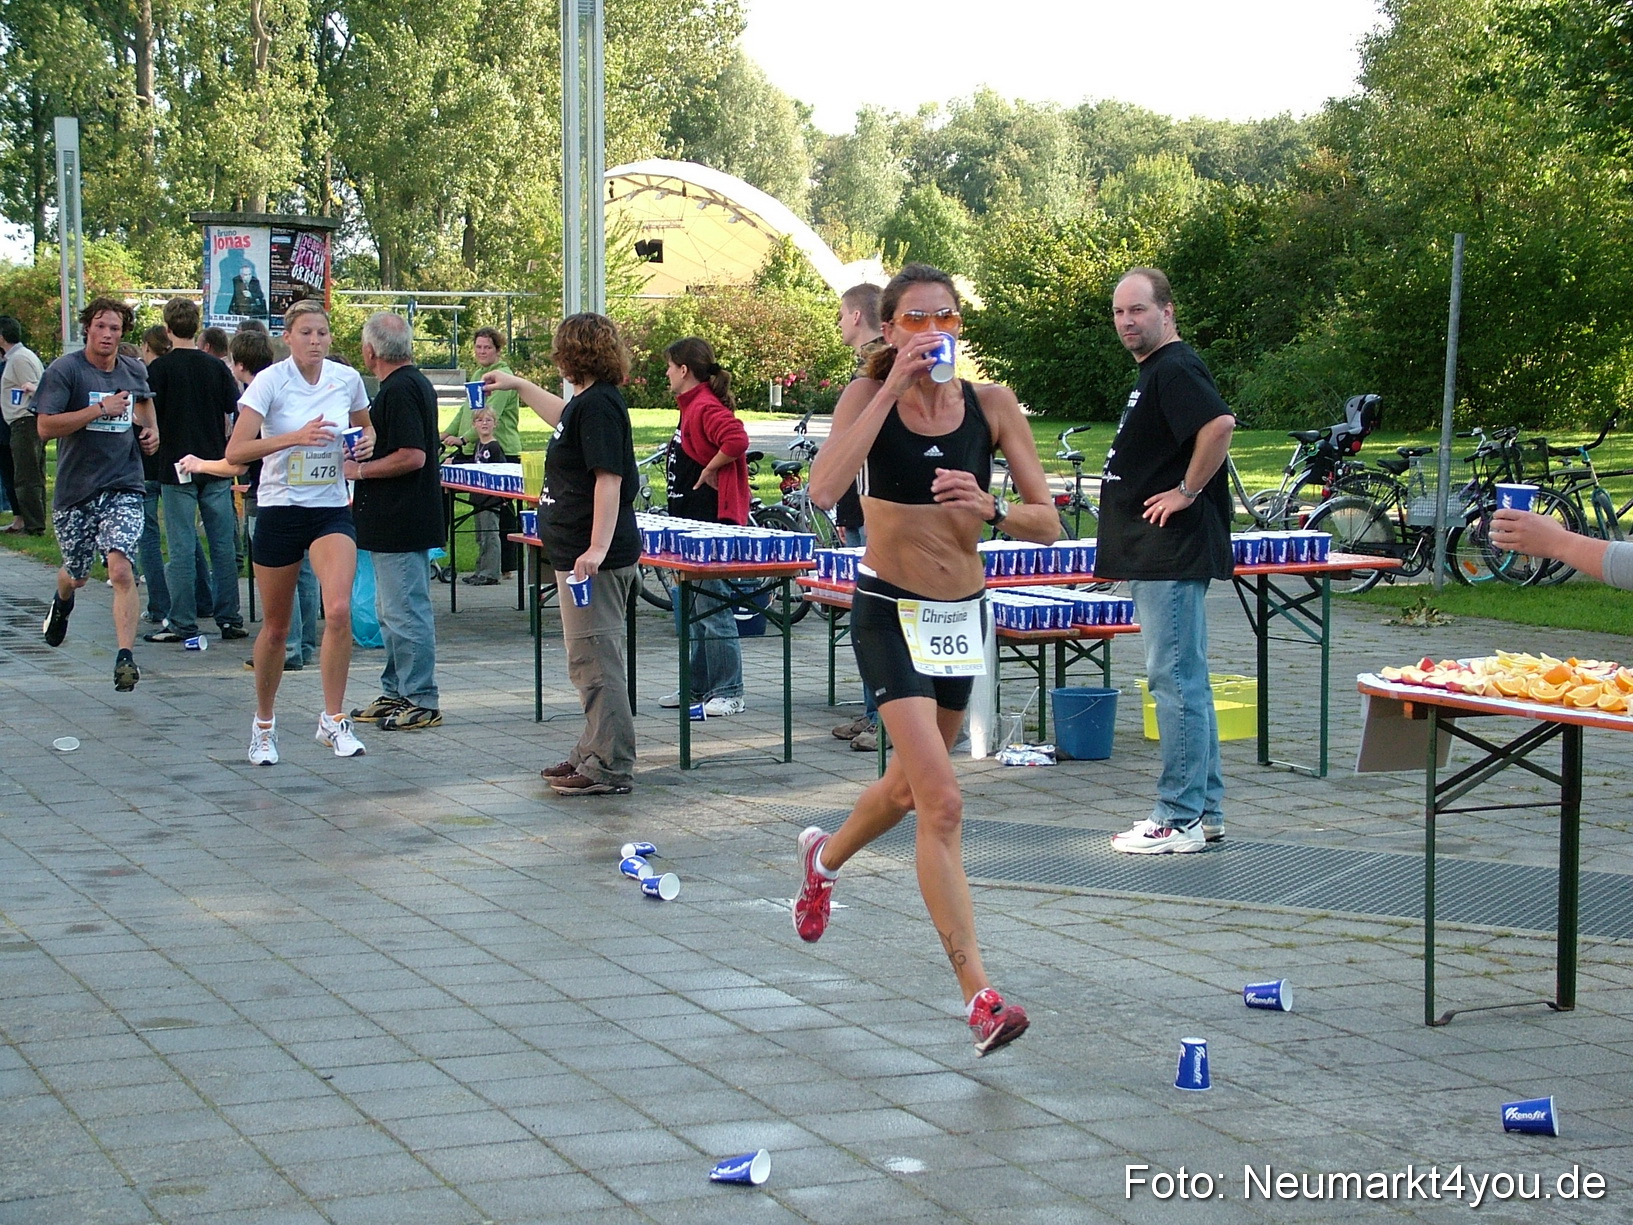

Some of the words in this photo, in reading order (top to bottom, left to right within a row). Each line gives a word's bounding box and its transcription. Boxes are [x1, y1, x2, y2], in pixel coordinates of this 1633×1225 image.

[217, 229, 237, 237] Bruno
[213, 234, 251, 255] Jonas
[294, 246, 326, 277] ROCK
[291, 263, 324, 291] 08.09.07
[310, 465, 336, 479] 478
[922, 607, 968, 624] Christine
[930, 634, 969, 656] 586
[1505, 1106, 1547, 1121] Xenofit
